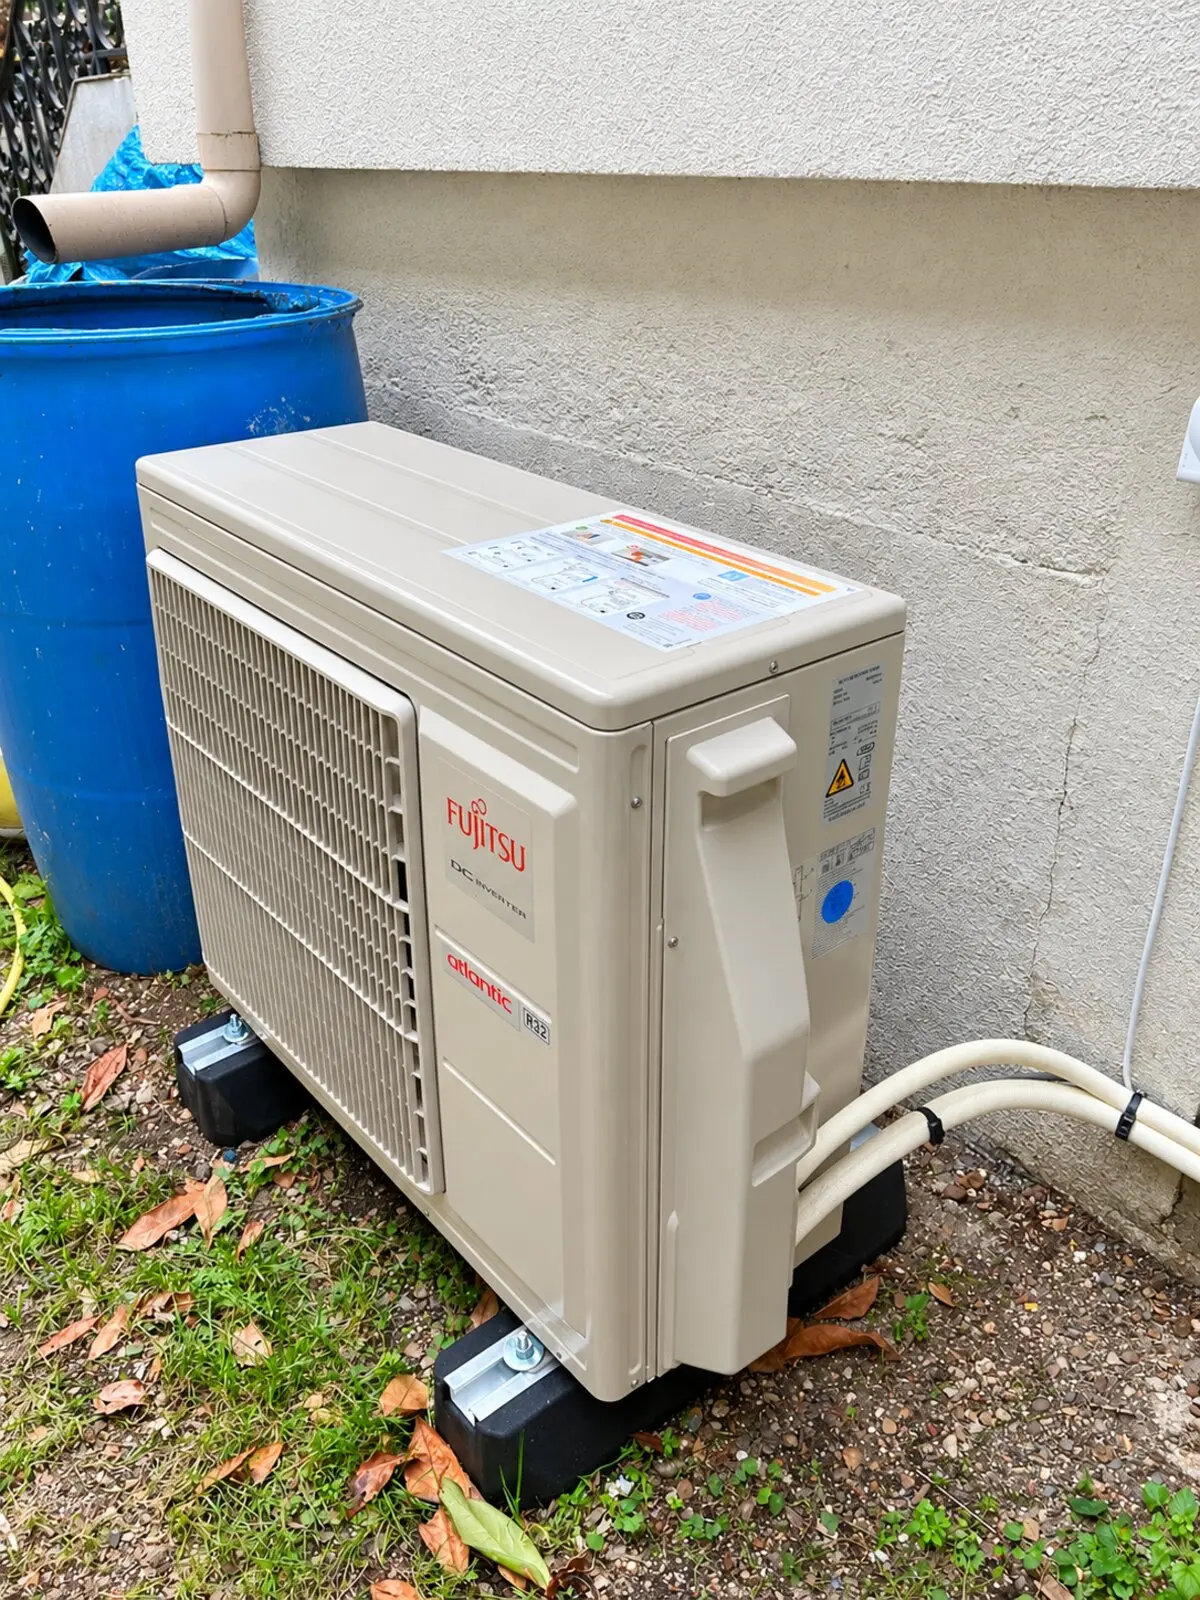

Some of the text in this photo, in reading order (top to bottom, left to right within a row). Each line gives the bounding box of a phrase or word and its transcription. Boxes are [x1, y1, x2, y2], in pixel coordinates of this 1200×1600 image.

[446, 797, 527, 873] FUJITSU
[450, 858, 528, 920] DC INVERTER
[447, 953, 512, 1014] atlantic
[525, 1012, 548, 1040] R32
